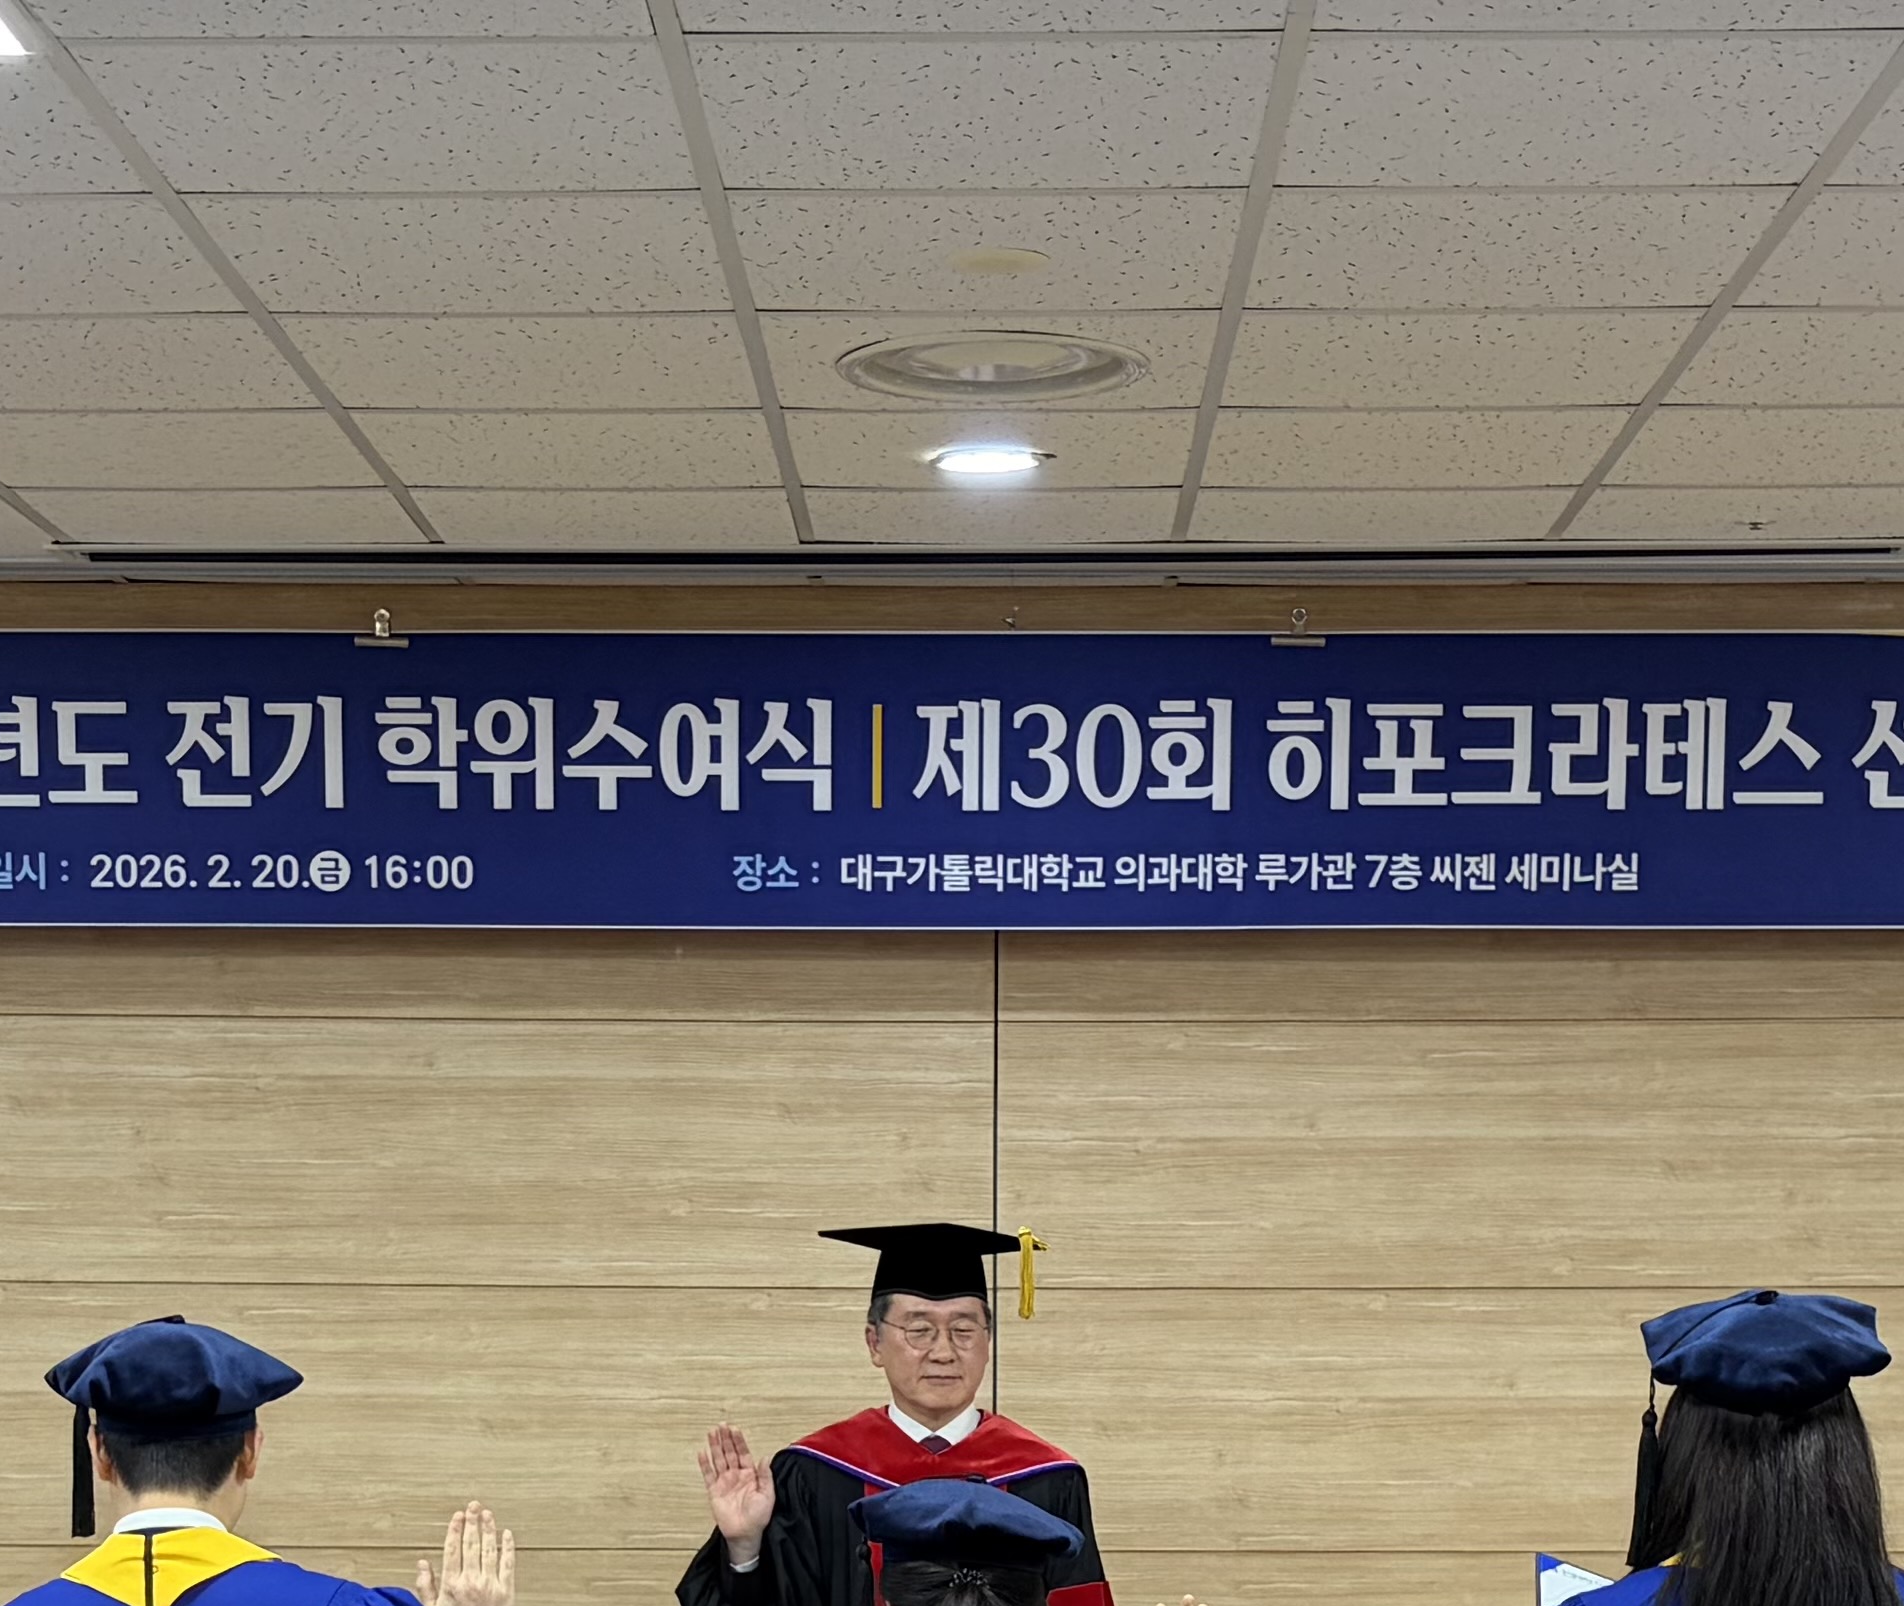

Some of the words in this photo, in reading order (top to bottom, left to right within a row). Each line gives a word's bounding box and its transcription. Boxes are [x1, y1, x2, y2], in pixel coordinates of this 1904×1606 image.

[165, 695, 345, 809] 전기
[375, 696, 832, 811] 학위수여식
[912, 697, 1233, 812] 제30회
[1266, 697, 1824, 810] 히포크라테스
[89, 853, 198, 889] 2026.
[207, 853, 242, 889] 2.
[363, 853, 475, 890] 16:00
[840, 853, 1107, 893] 대구가톨릭대학교
[1113, 853, 1250, 892] 의과대학
[1254, 852, 1357, 892] 루가관
[1364, 853, 1424, 891] 7층
[1429, 853, 1496, 892] 씨젠
[1504, 852, 1640, 892] 세미나실
